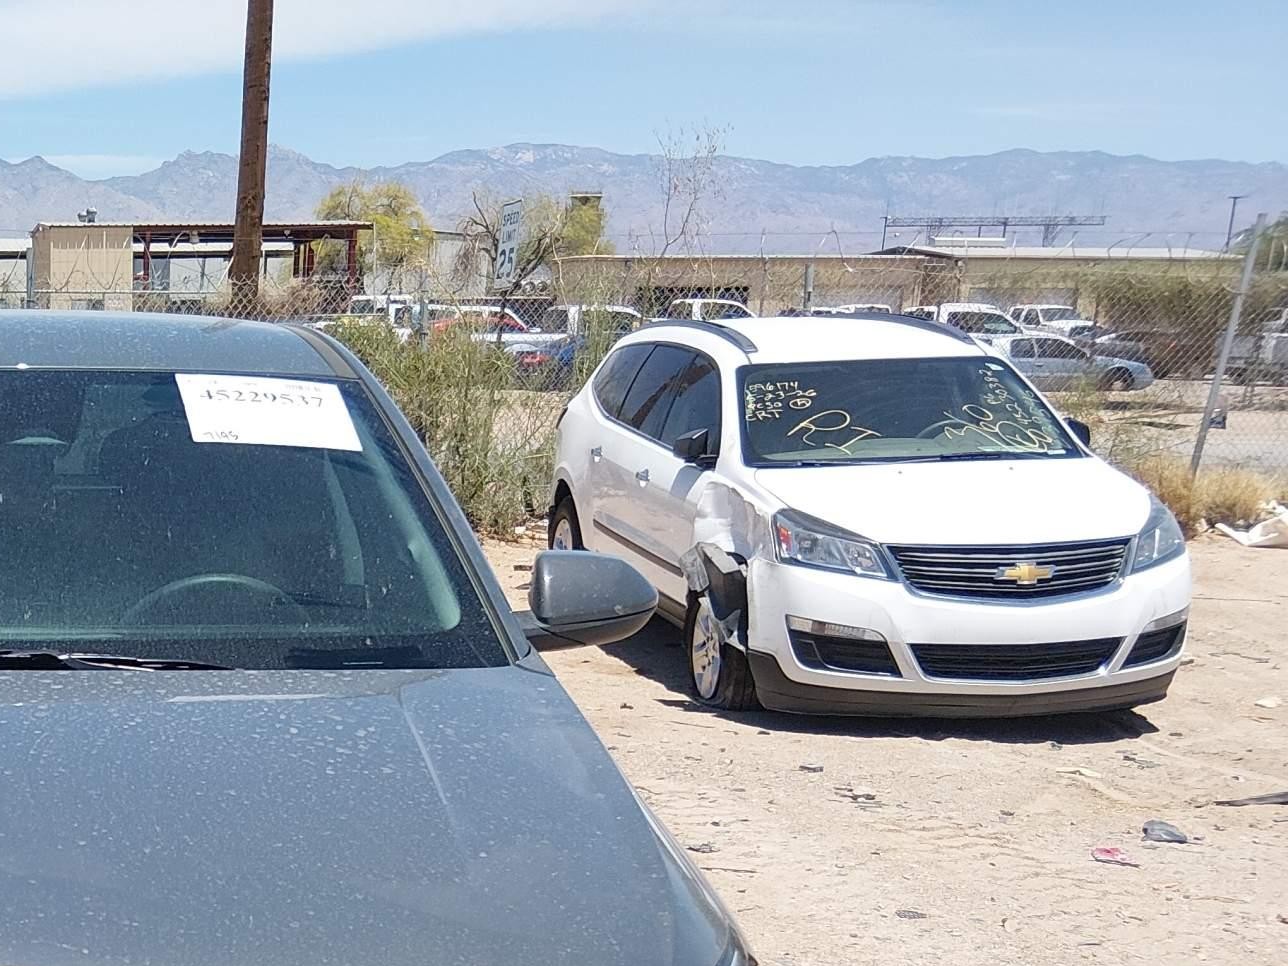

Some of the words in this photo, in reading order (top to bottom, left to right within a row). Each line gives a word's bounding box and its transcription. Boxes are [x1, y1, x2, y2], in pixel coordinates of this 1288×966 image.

[503, 211, 520, 227] SPEED
[501, 228, 517, 244] LIMIT
[496, 247, 515, 279] 25
[199, 388, 324, 409] 45229537
